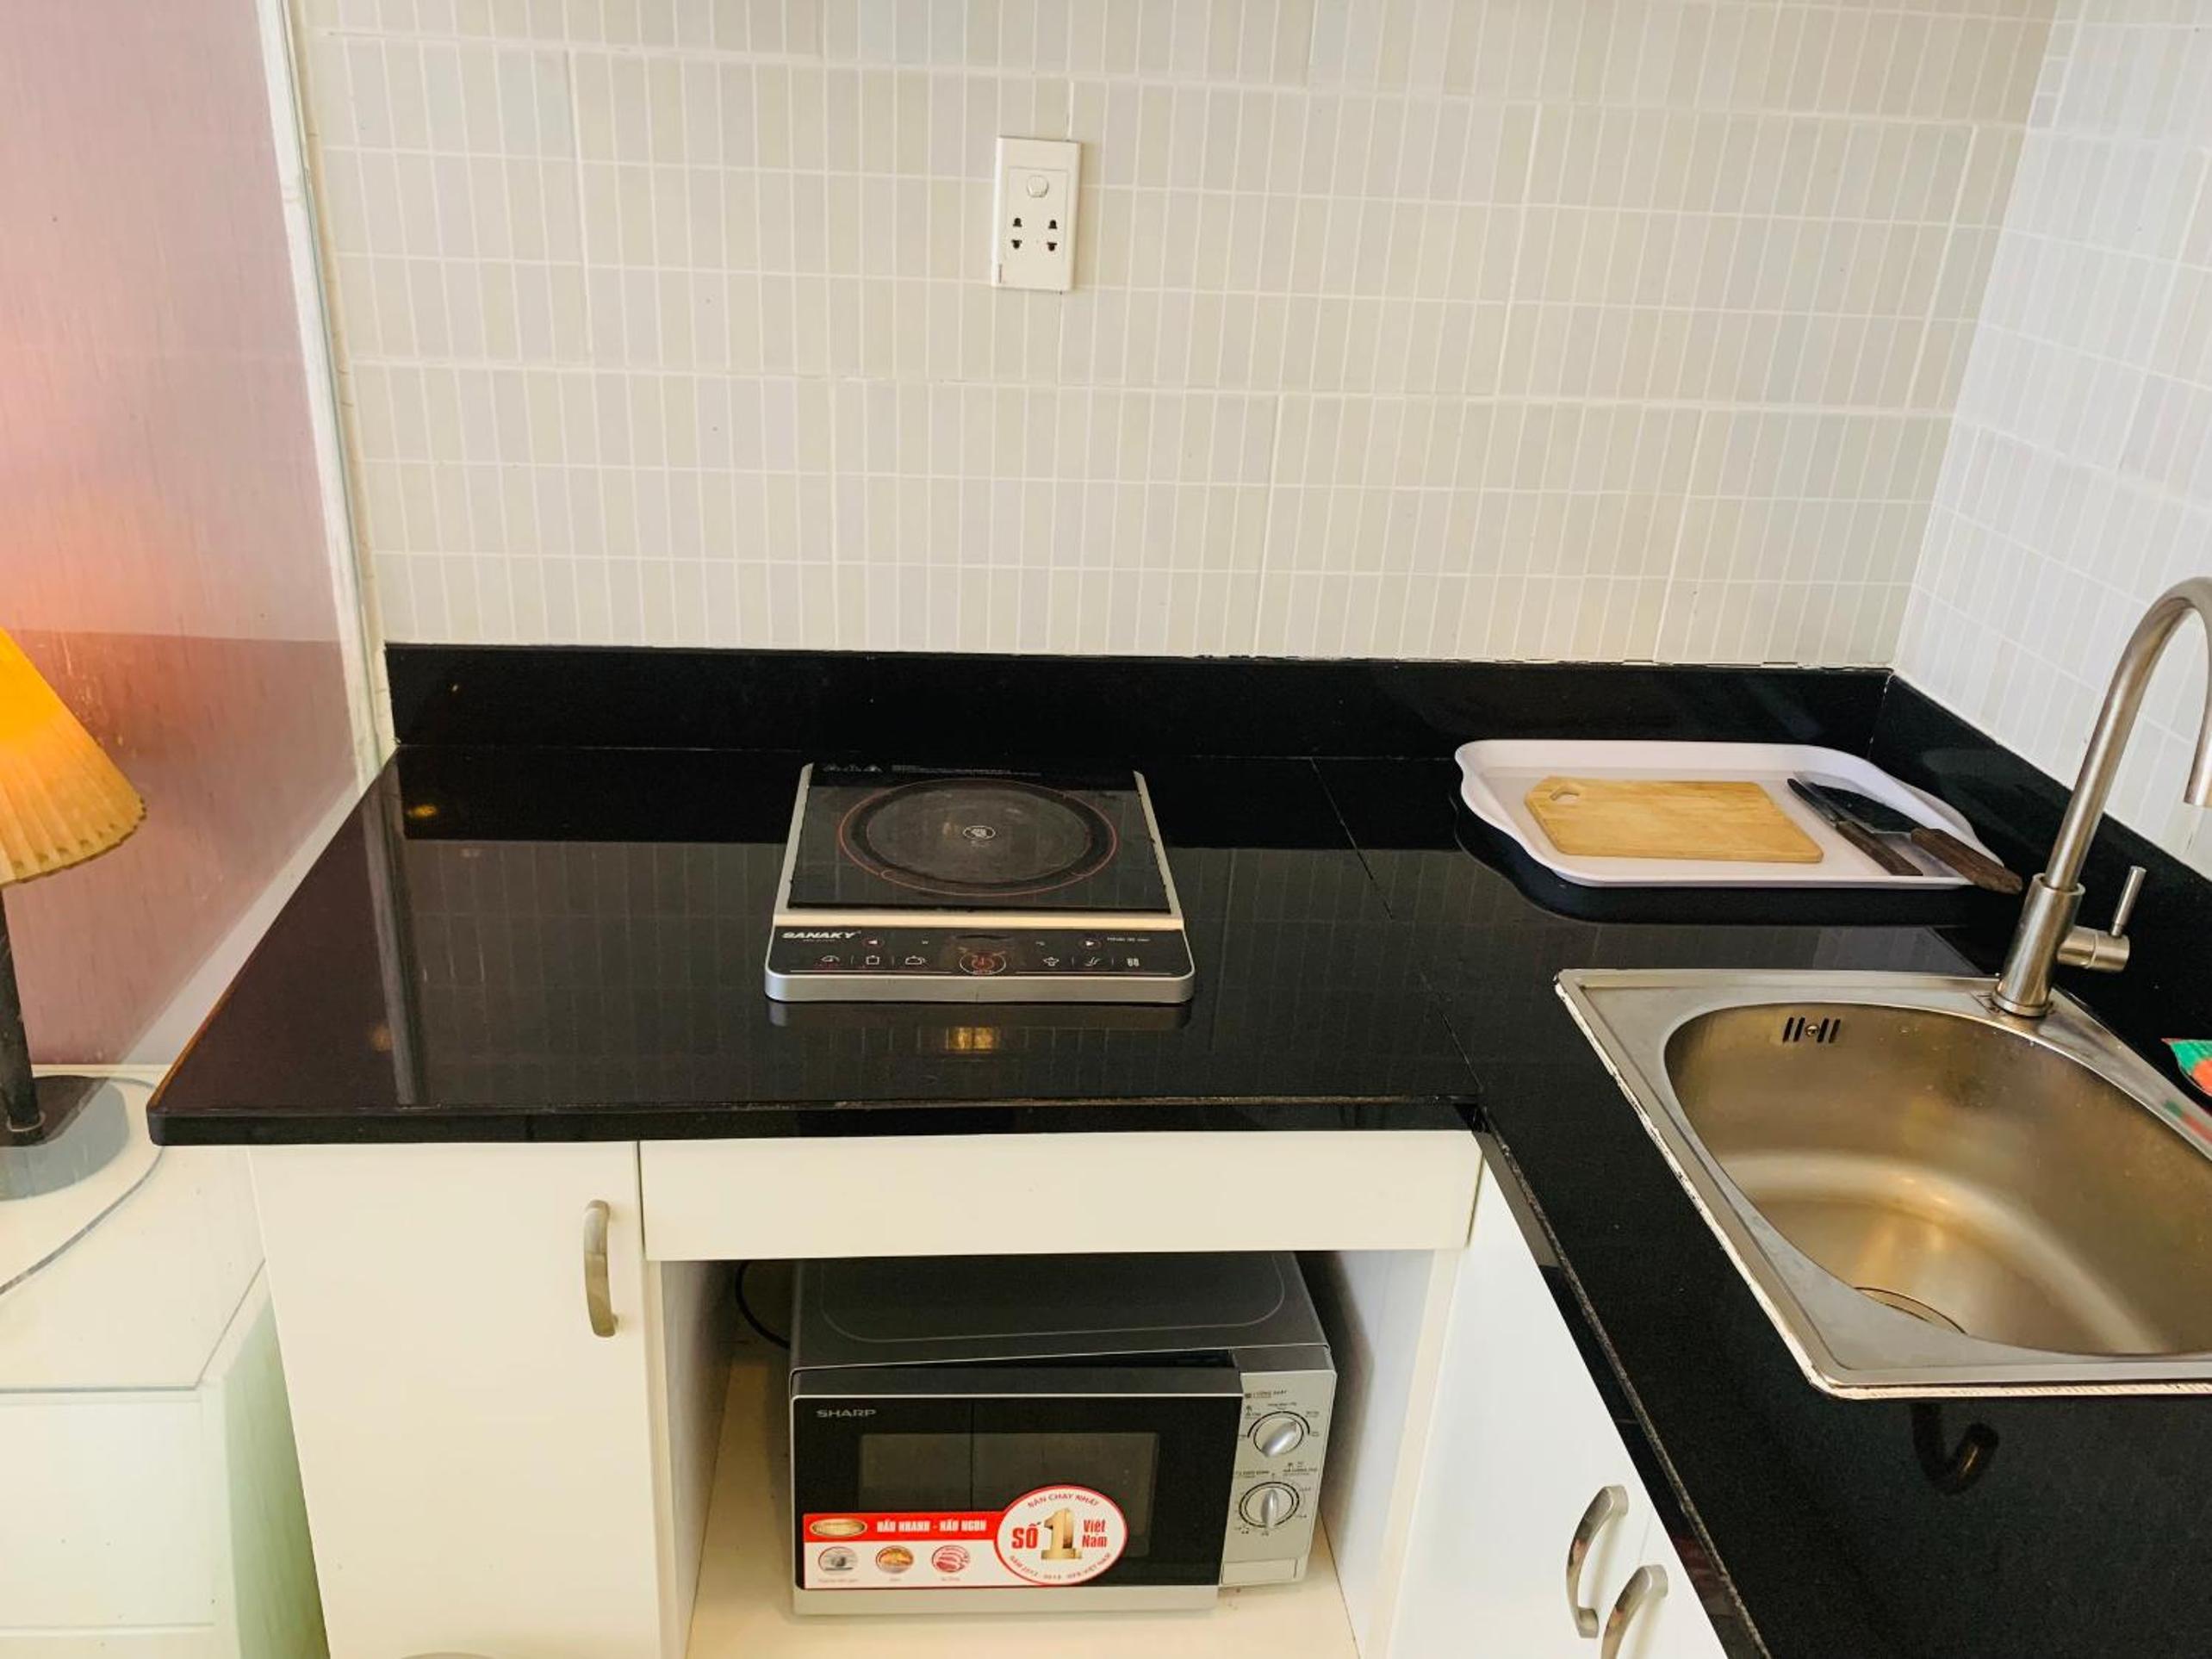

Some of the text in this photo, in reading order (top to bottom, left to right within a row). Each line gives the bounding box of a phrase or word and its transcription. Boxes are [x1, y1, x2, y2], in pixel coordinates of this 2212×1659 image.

[816, 1408, 877, 1418] SHARP
[1011, 1507, 1083, 1560] SỐ 1
[1083, 1519, 1106, 1535] Việt
[1082, 1533, 1108, 1548] Nam
